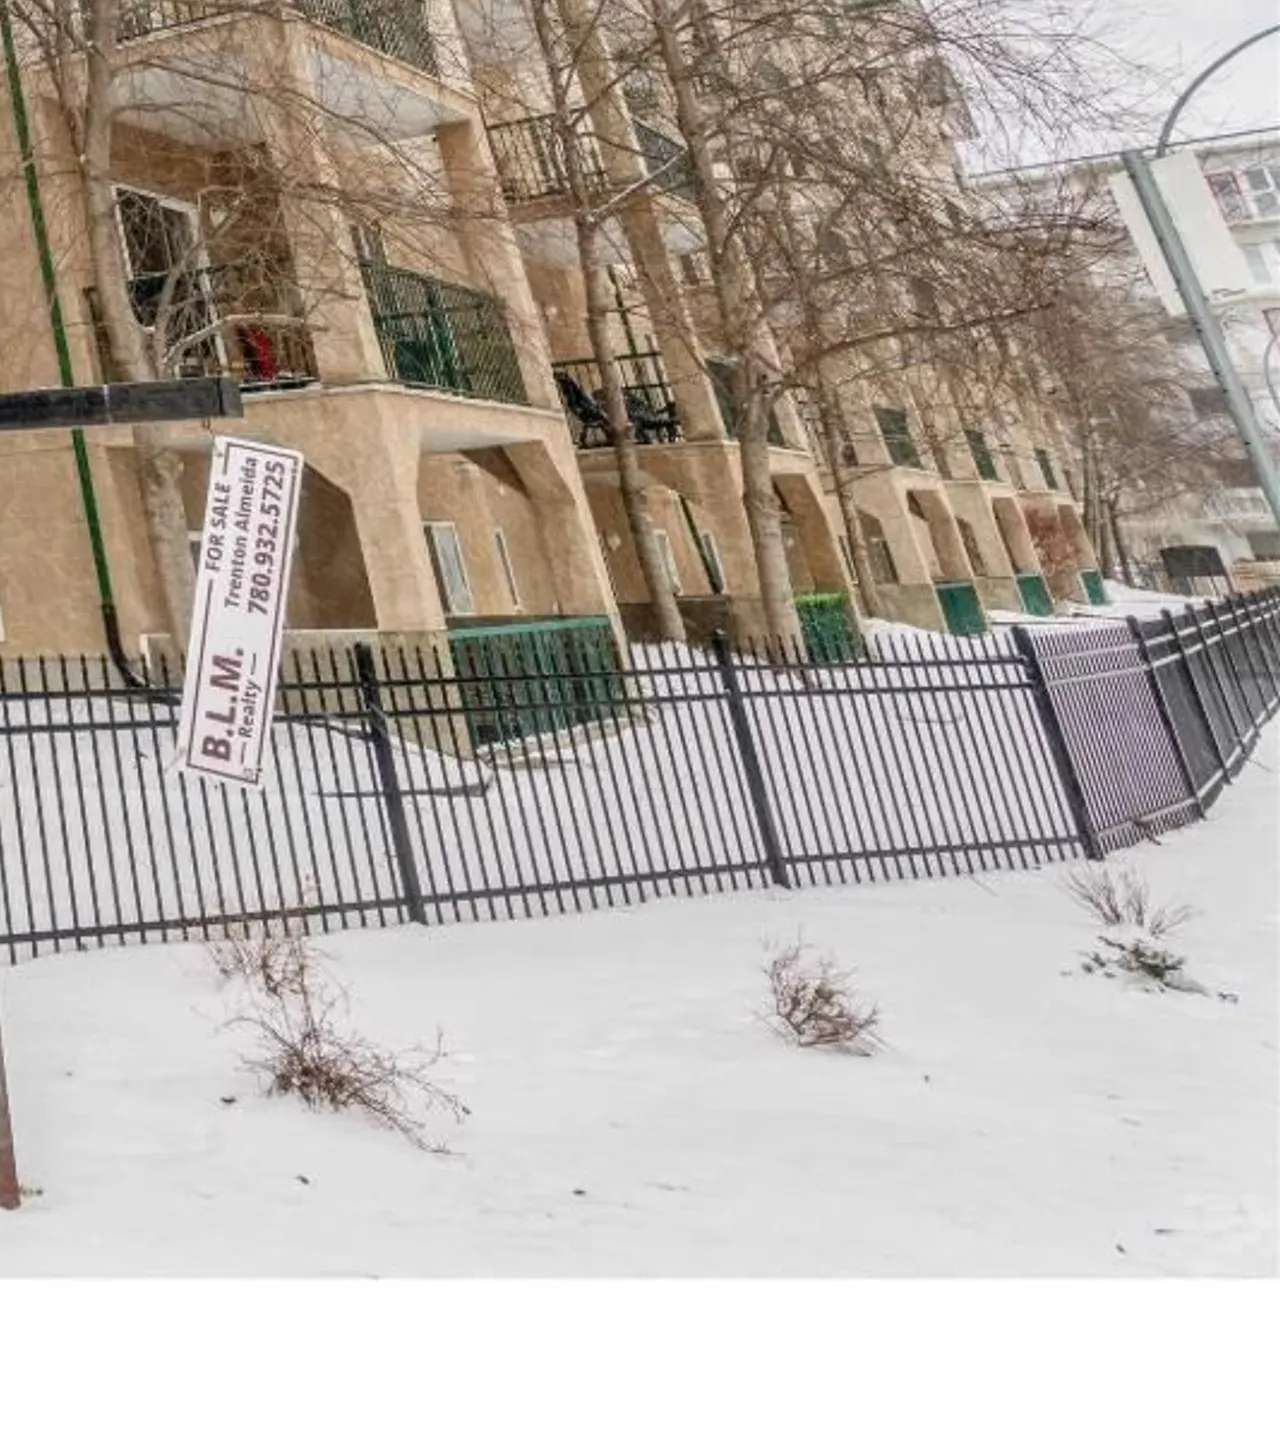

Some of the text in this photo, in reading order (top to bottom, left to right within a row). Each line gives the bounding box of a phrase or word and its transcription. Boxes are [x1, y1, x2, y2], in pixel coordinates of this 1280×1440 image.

[205, 482, 231, 573] FOR SALE
[224, 457, 258, 609] Trenton Almeida
[248, 460, 285, 616] 780.932.5725
[202, 647, 244, 762] B.L.M.
[238, 679, 262, 739] Realty
